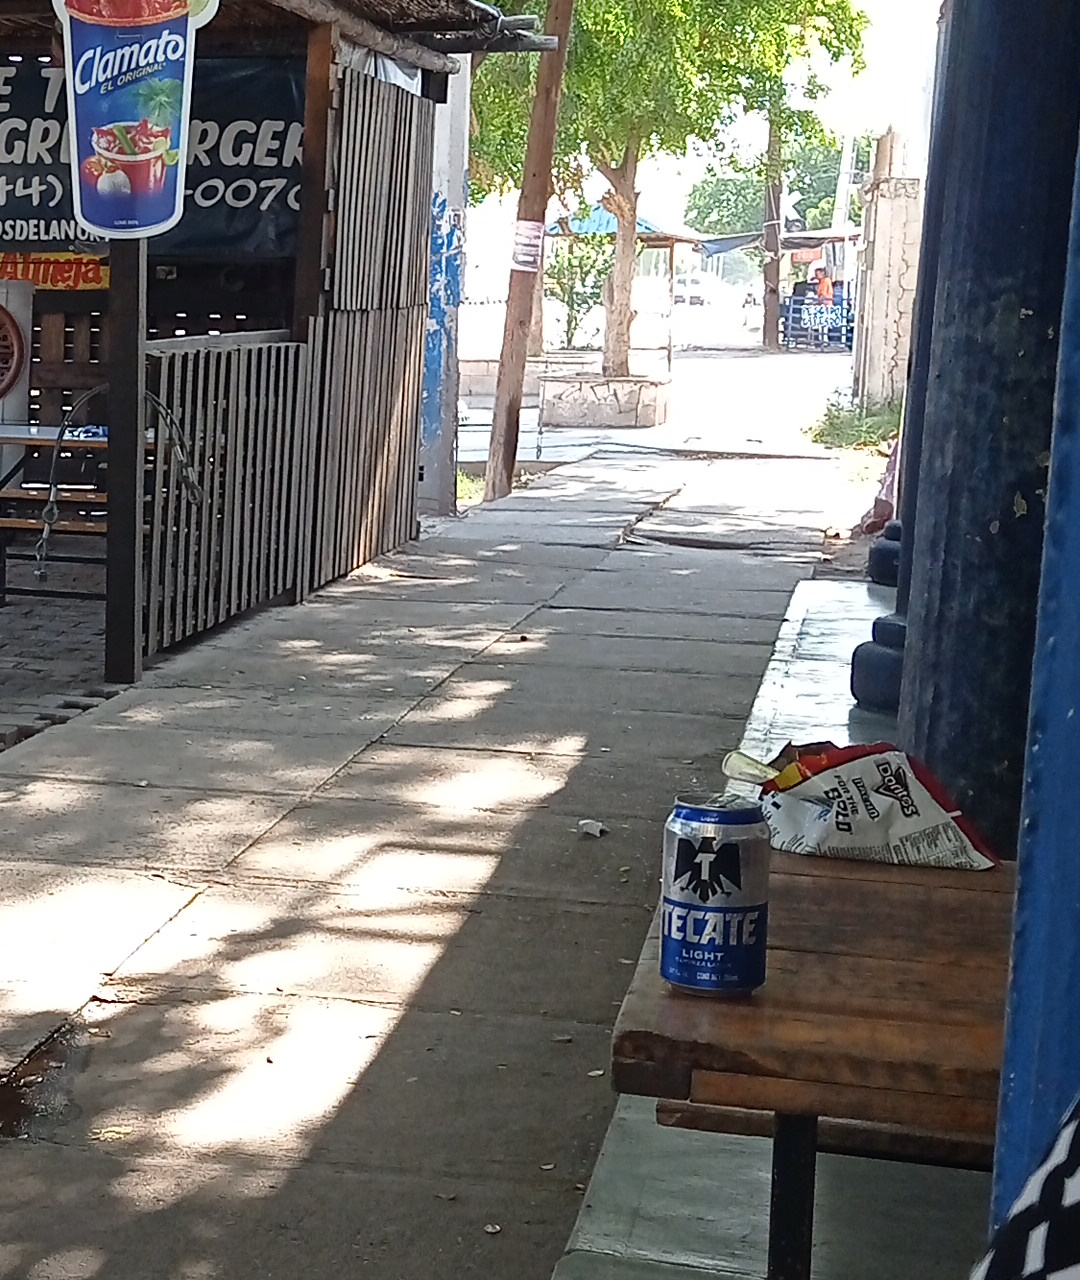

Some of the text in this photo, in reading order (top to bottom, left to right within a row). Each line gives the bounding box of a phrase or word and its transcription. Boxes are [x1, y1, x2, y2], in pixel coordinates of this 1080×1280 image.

[74, 29, 185, 94] Clamato
[100, 62, 163, 94] EL ORIGINAL
[41, 67, 66, 113] T
[846, 795, 860, 816] THE
[877, 761, 920, 818] Doritos
[663, 902, 759, 946] TECATE
[682, 948, 724, 962] LIGHT
